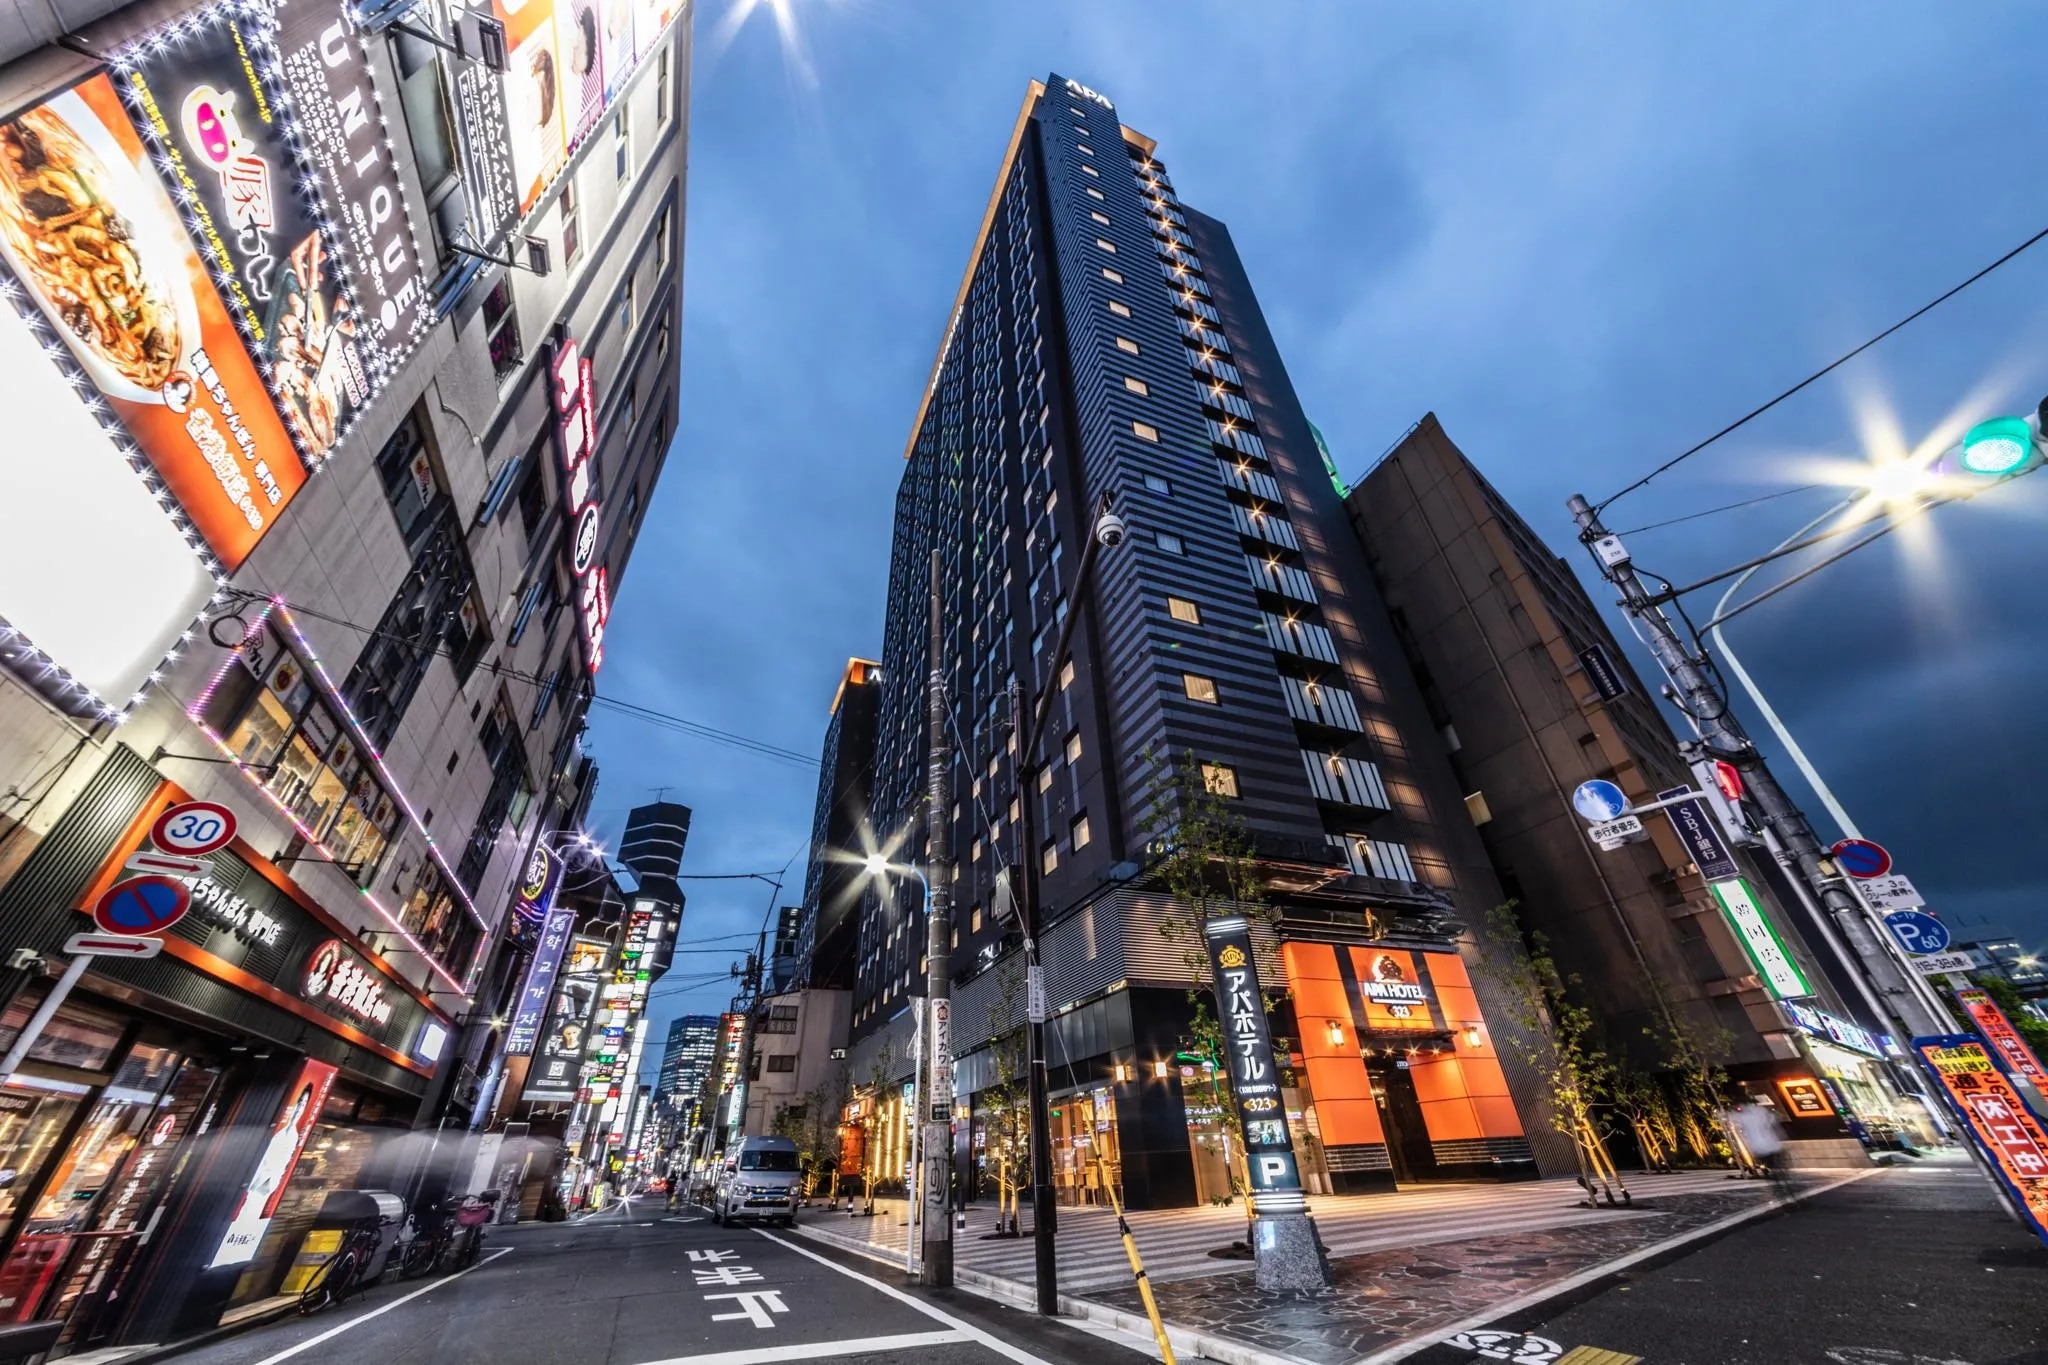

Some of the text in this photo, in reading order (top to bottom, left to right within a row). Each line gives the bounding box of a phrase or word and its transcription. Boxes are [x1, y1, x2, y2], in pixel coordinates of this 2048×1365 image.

[305, 40, 351, 165] K-POP KARAOKE
[1065, 79, 1114, 110] APA
[487, 66, 514, 214] 内求人ダイヤル
[320, 18, 418, 317] UNIQUE
[171, 815, 221, 843] 30
[1593, 820, 1639, 840] 歩行者優先
[1679, 807, 1717, 862] SBJ銀行
[1893, 922, 1920, 952] P
[1388, 984, 1426, 999] HOTEL
[938, 1021, 947, 1066] アイカワ
[1225, 971, 1266, 1081] アパホテル
[1249, 1098, 1272, 1112] 323
[1977, 1098, 2046, 1172] 休工中
[1260, 1157, 1286, 1185] P
[685, 1249, 790, 1328] 止まれ
